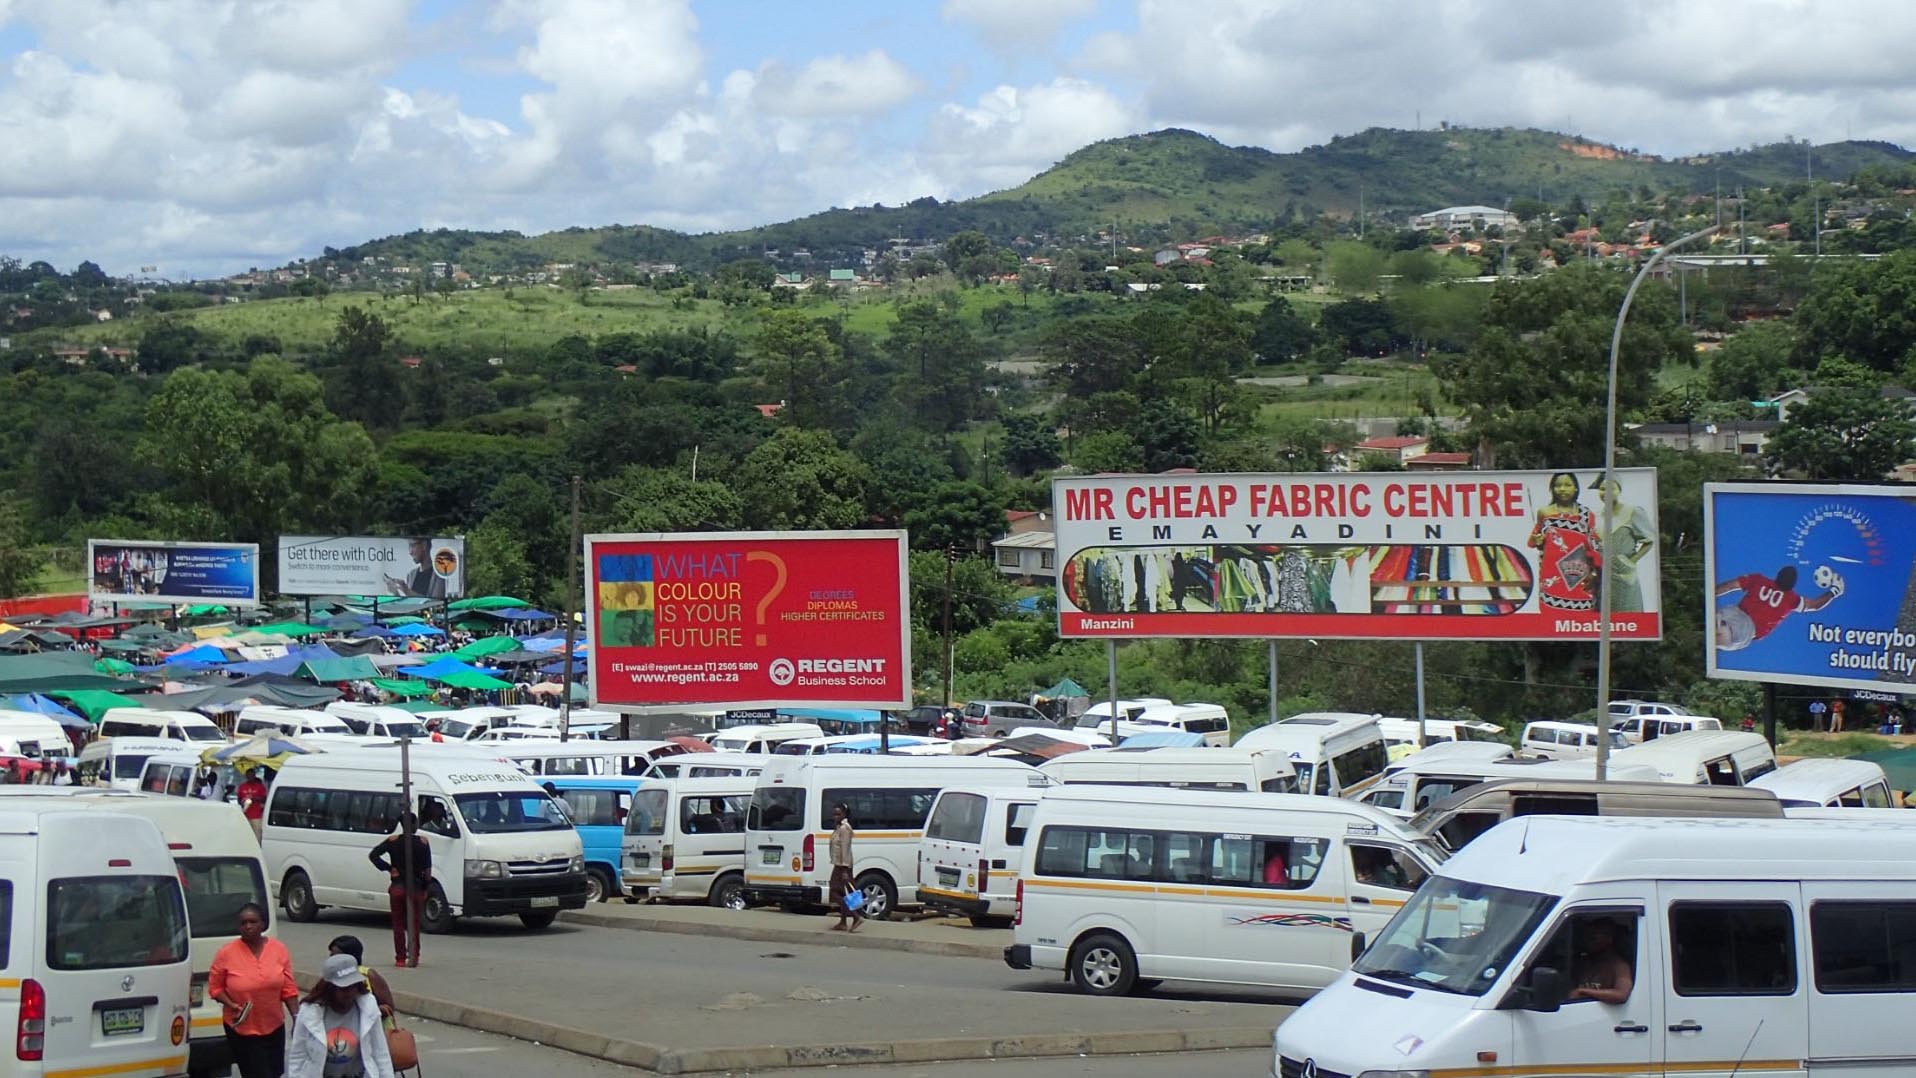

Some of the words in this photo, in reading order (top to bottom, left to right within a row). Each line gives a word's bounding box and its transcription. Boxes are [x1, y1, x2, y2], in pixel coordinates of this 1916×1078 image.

[1065, 488, 1116, 520] MR
[1125, 484, 1238, 519] CHEAP
[1250, 483, 1372, 518] FABRIC
[1383, 482, 1525, 517] CENTRE
[1108, 524, 1481, 541] EMAYADINI
[287, 546, 308, 560] Get
[309, 546, 338, 561] there
[340, 546, 366, 561] with
[368, 547, 397, 562] Gold.
[656, 553, 744, 579] WHAT
[658, 582, 741, 600] COLOUR
[809, 591, 854, 600] DEGREES
[659, 604, 676, 622] IS
[683, 603, 741, 622] YOUR
[807, 601, 858, 610] DIPLOMAS
[781, 612, 816, 621] HIGHER
[819, 611, 885, 621] CERTIFICATES
[1081, 618, 1134, 631] Manzini
[659, 628, 743, 647] FUTURE
[1809, 624, 1840, 643] Not
[625, 663, 703, 672] swazi@regent.ac.za
[718, 662, 737, 670] 2505
[798, 659, 885, 673] REGENT
[1830, 649, 1888, 670] should
[1893, 652, 1916, 676] fly
[631, 672, 739, 685] www.regent.ac.za
[798, 676, 846, 686] Business
[848, 676, 886, 686] School
[1854, 690, 1896, 702] JCDecaux
[730, 710, 771, 719] JCDecaux
